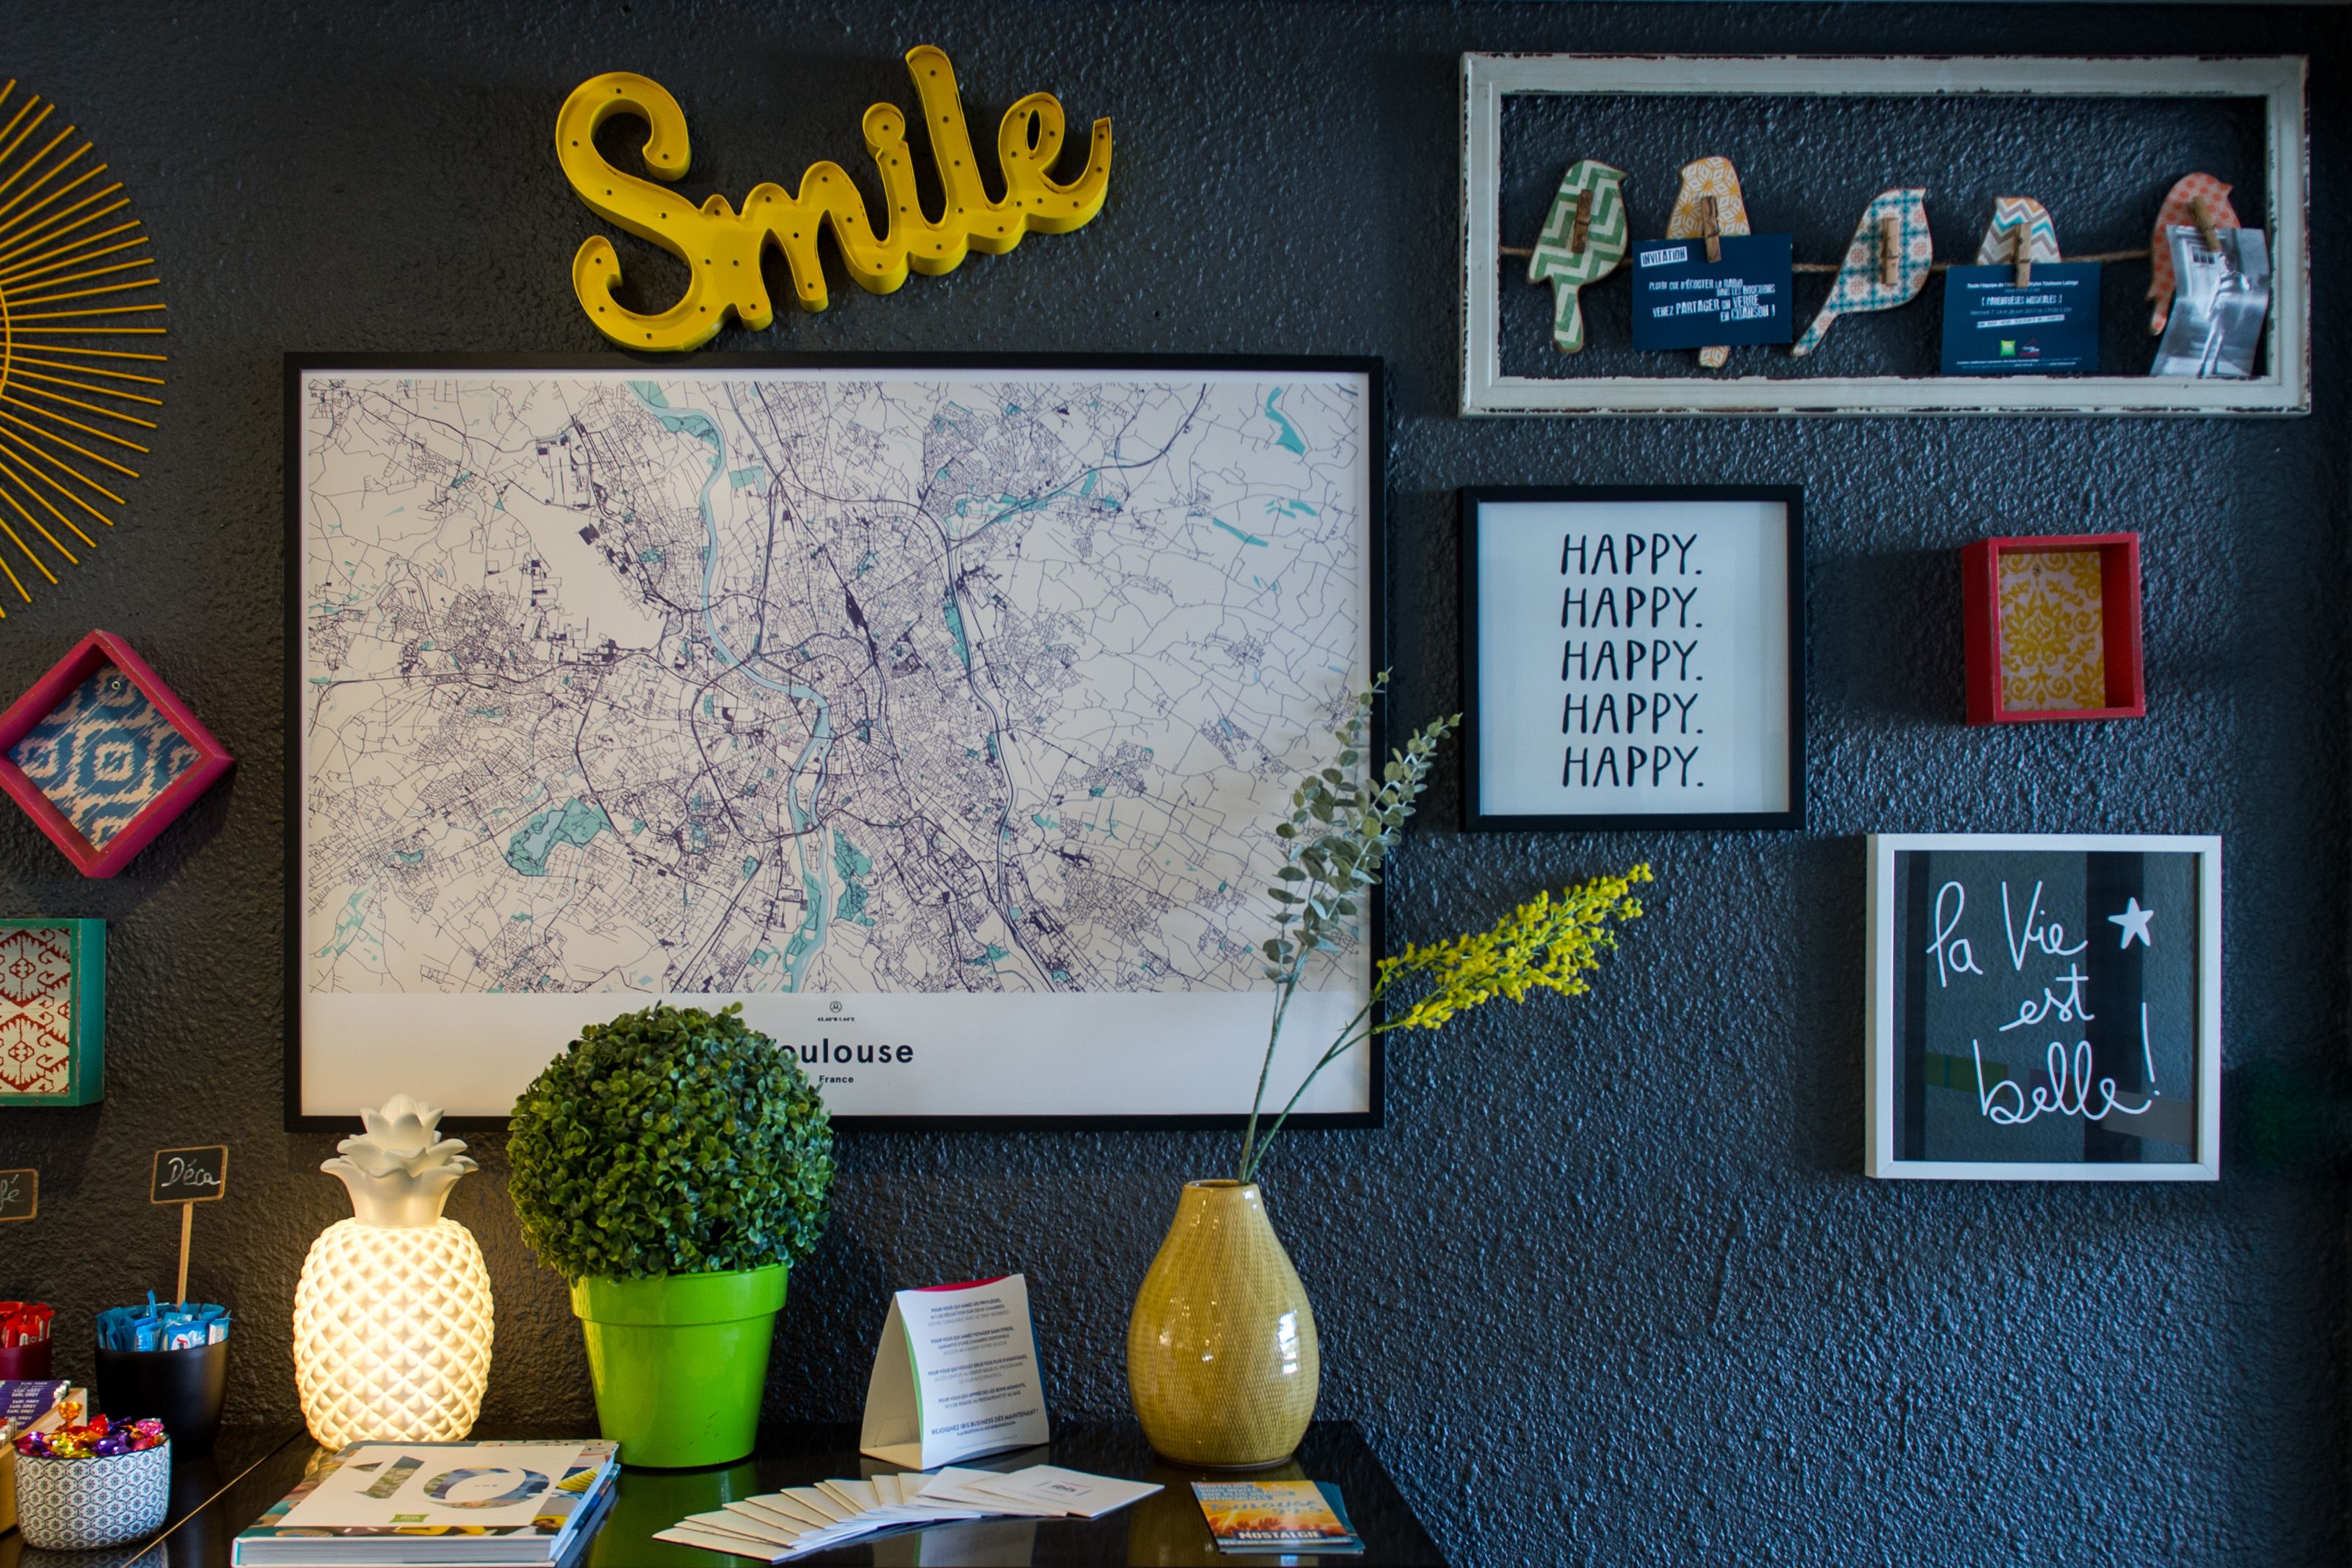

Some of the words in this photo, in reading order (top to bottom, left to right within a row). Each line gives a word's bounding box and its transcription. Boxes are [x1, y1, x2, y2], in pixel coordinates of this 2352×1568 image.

[556, 45, 1112, 352] Smile
[1642, 247, 1686, 265] INVITATION
[1724, 279, 1743, 288] RADIO
[1653, 306, 1674, 318] VENEZ
[1675, 298, 1720, 315] PARTAGER
[1732, 294, 1759, 308] VERRE
[1720, 311, 1729, 322] EN
[1731, 304, 1769, 321] CHANSON
[1561, 533, 1702, 575] HAPPY.
[1561, 586, 1702, 628] HAPPY.
[1562, 639, 1703, 681] HAPPY.
[1562, 692, 1703, 734] HAPPY.
[1562, 745, 1703, 788] HAPPY.
[2002, 880, 2088, 971] Vie
[1999, 963, 2095, 1032] est
[161, 1157, 221, 1188] Déca
[932, 1425, 959, 1435] REJOIGNEZ
[971, 1417, 994, 1427] BUSINESS
[1004, 1409, 1036, 1419] MAINTENANT
